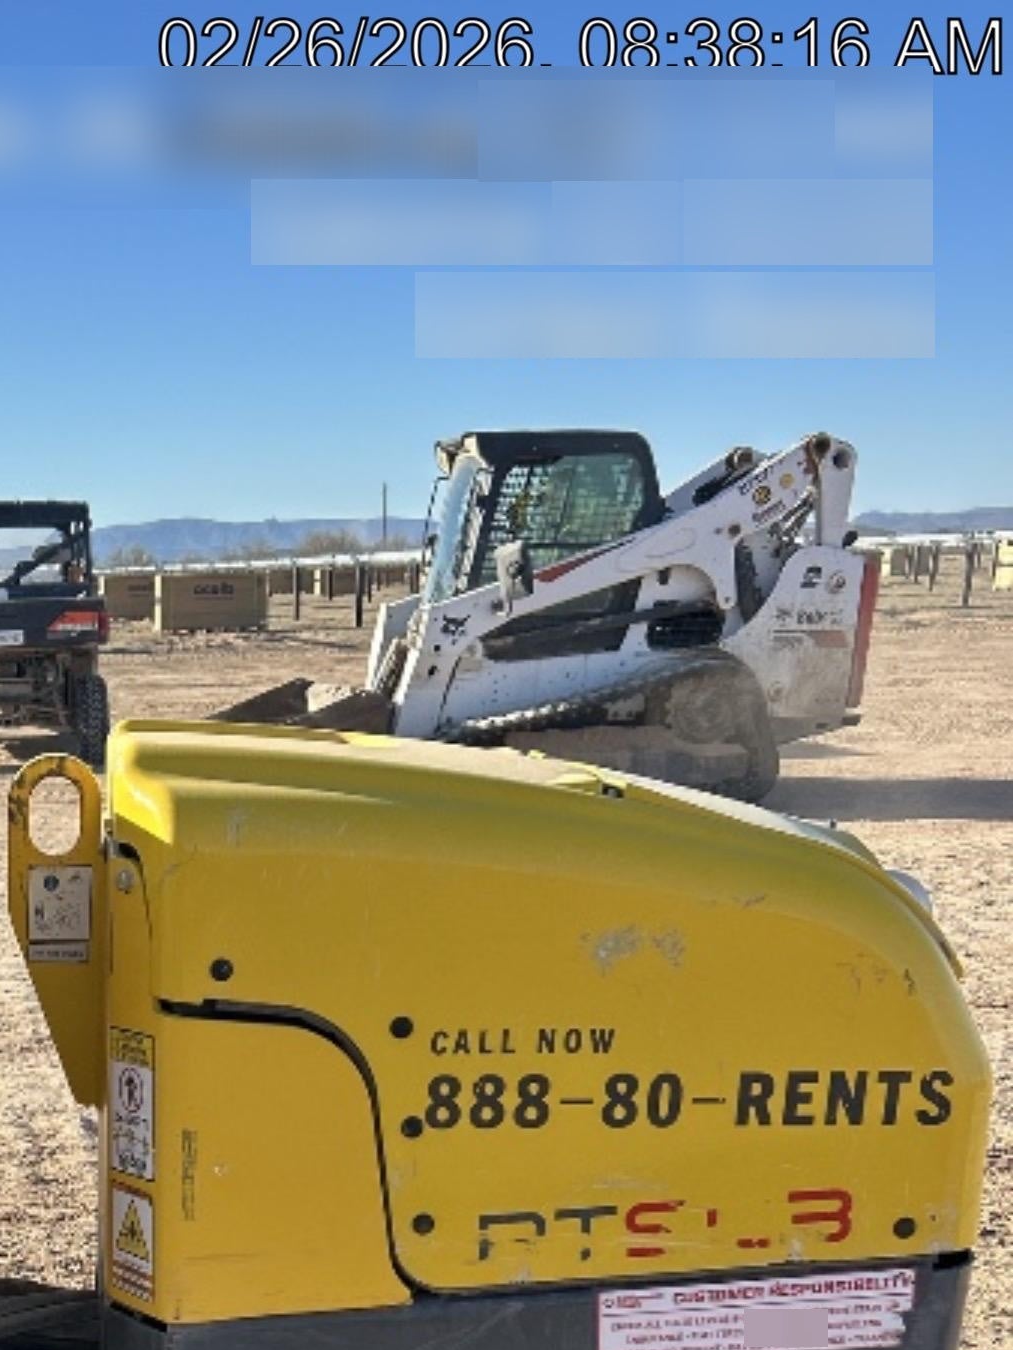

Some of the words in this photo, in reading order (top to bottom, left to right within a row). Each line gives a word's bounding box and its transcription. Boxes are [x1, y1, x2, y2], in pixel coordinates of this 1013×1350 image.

[430, 1028, 516, 1056] CALL
[536, 1027, 617, 1054] NOW
[424, 1070, 955, 1129] 888-80-RENTS
